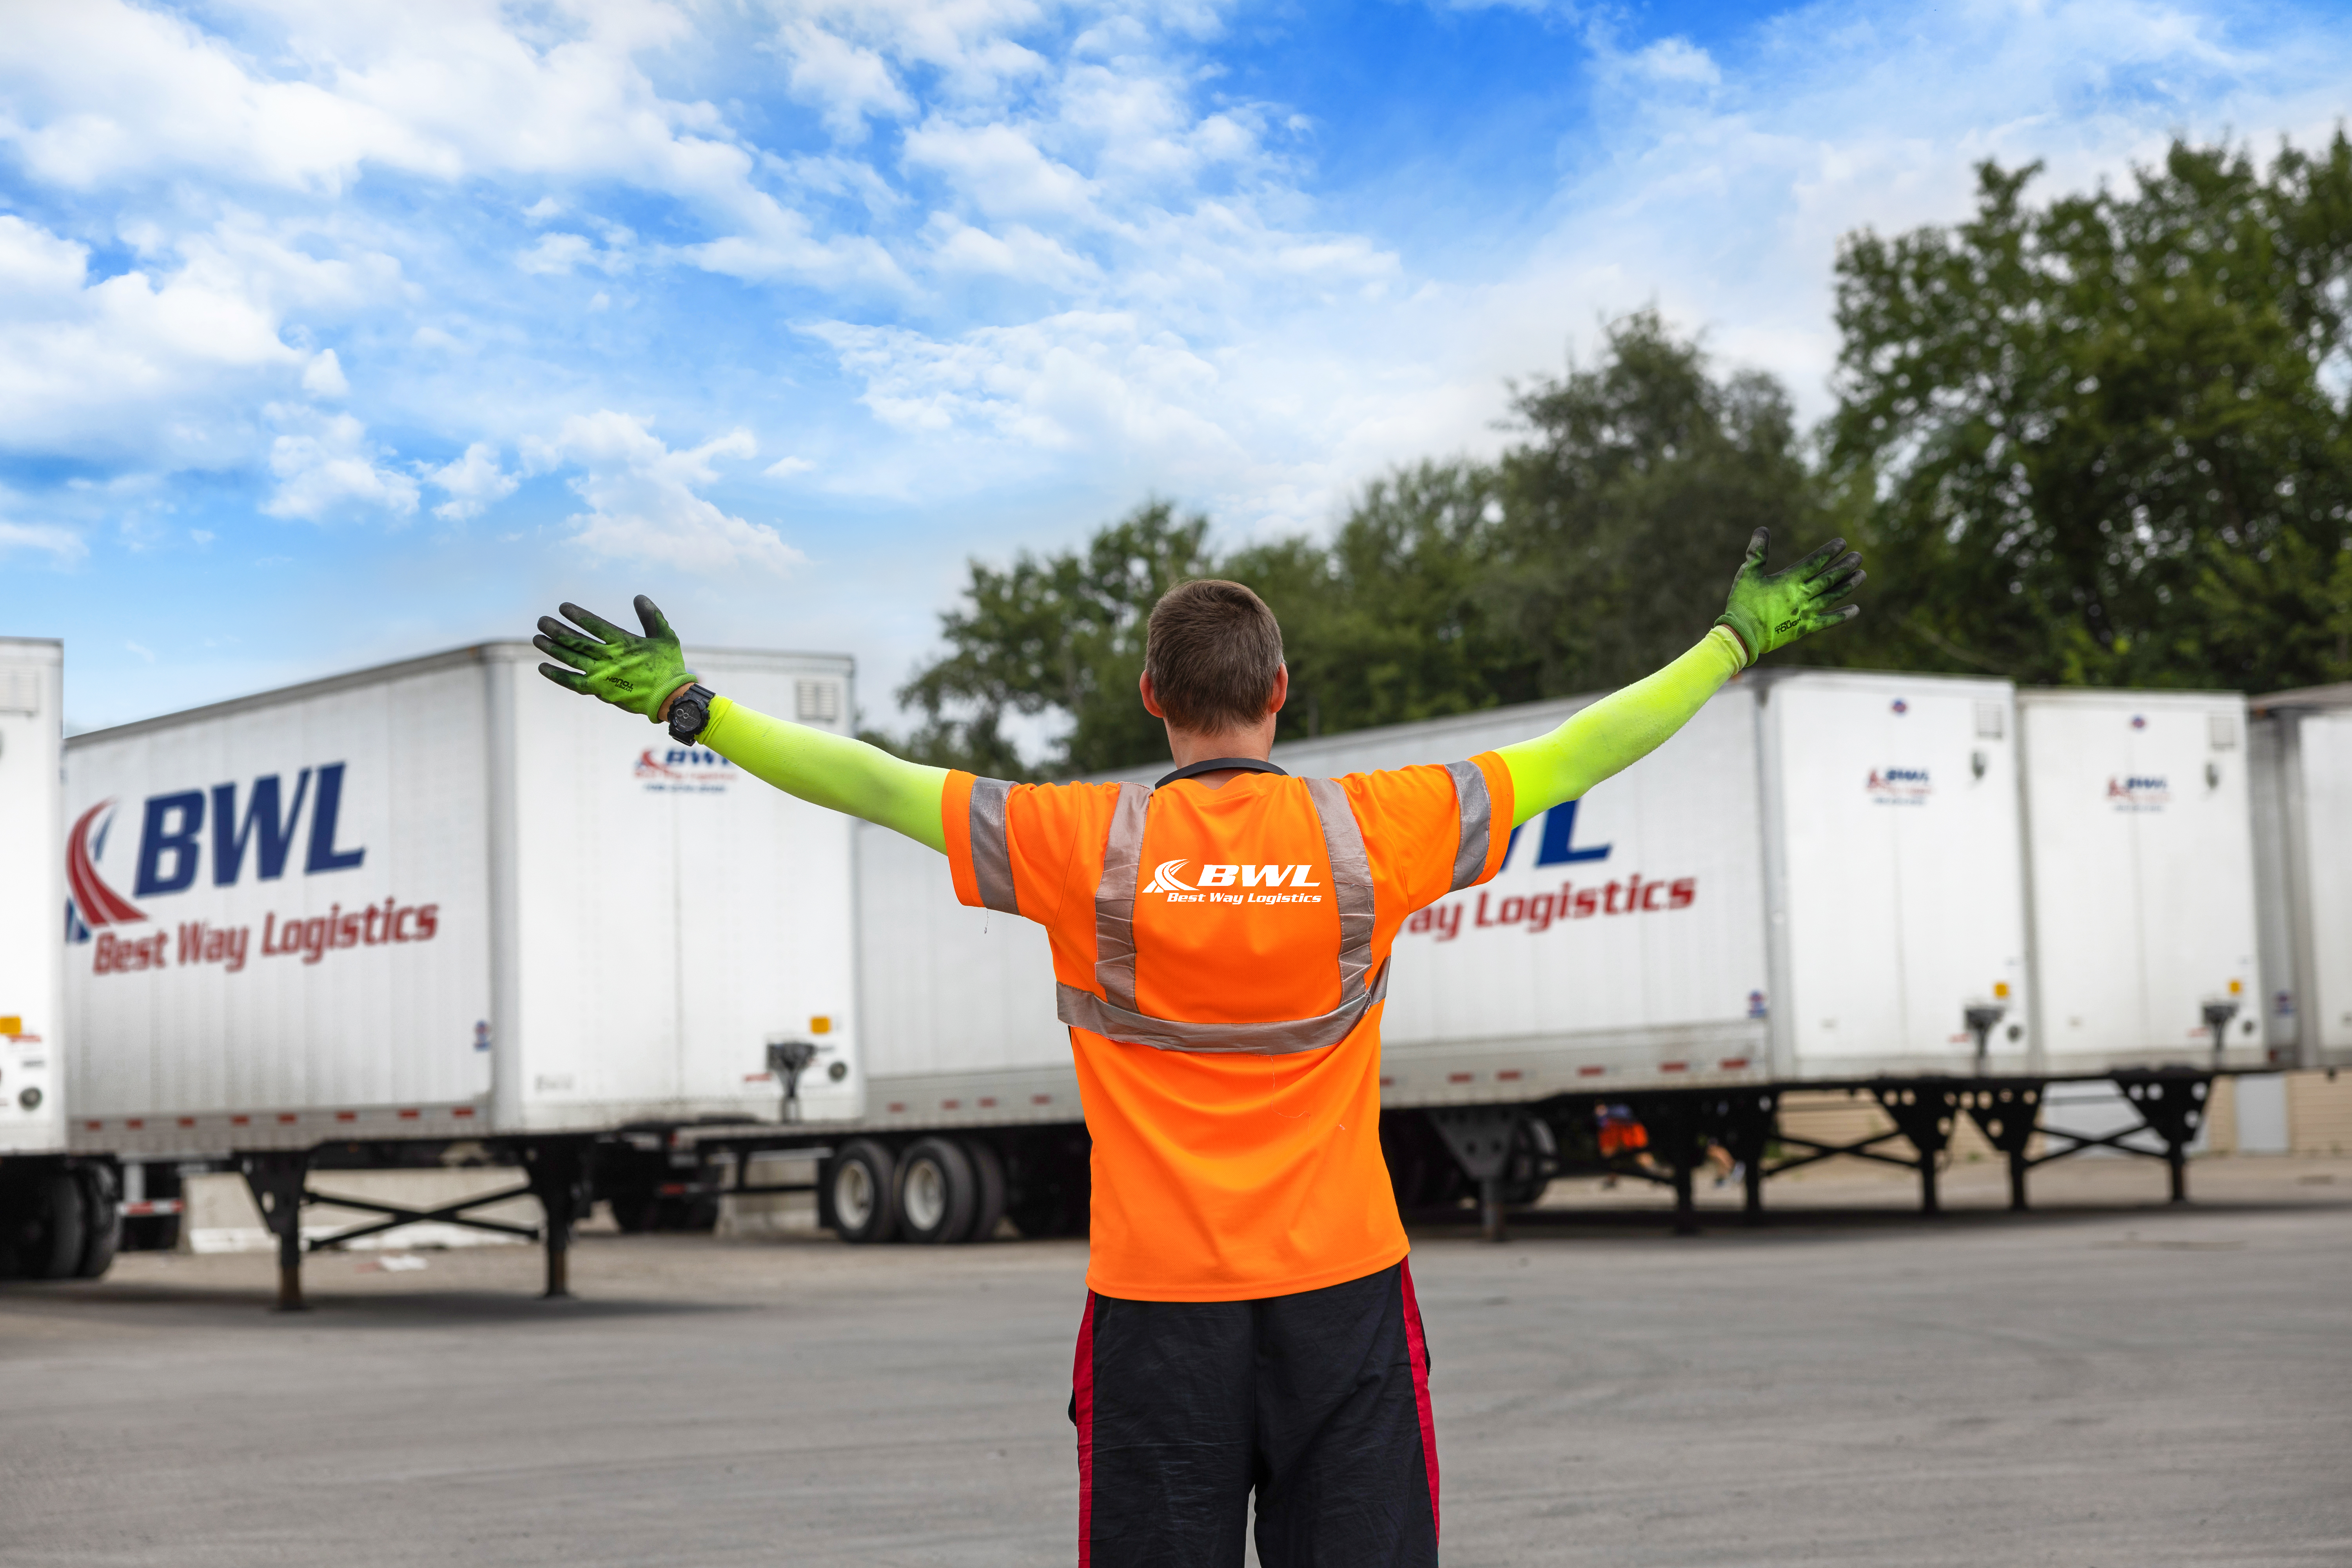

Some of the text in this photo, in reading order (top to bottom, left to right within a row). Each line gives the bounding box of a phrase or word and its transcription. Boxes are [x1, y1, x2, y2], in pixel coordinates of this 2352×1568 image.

[1775, 615, 1801, 634] TOUGH
[1775, 620, 1790, 630] HYPER
[604, 676, 633, 690] TOUGH
[615, 683, 632, 693] HYPER
[133, 761, 366, 899] BWL
[1196, 864, 1321, 887] BWL
[1167, 893, 1322, 905] Best Way Logistics
[1396, 874, 1696, 942] ay Logistics
[93, 897, 438, 975] Best Way Logistics
